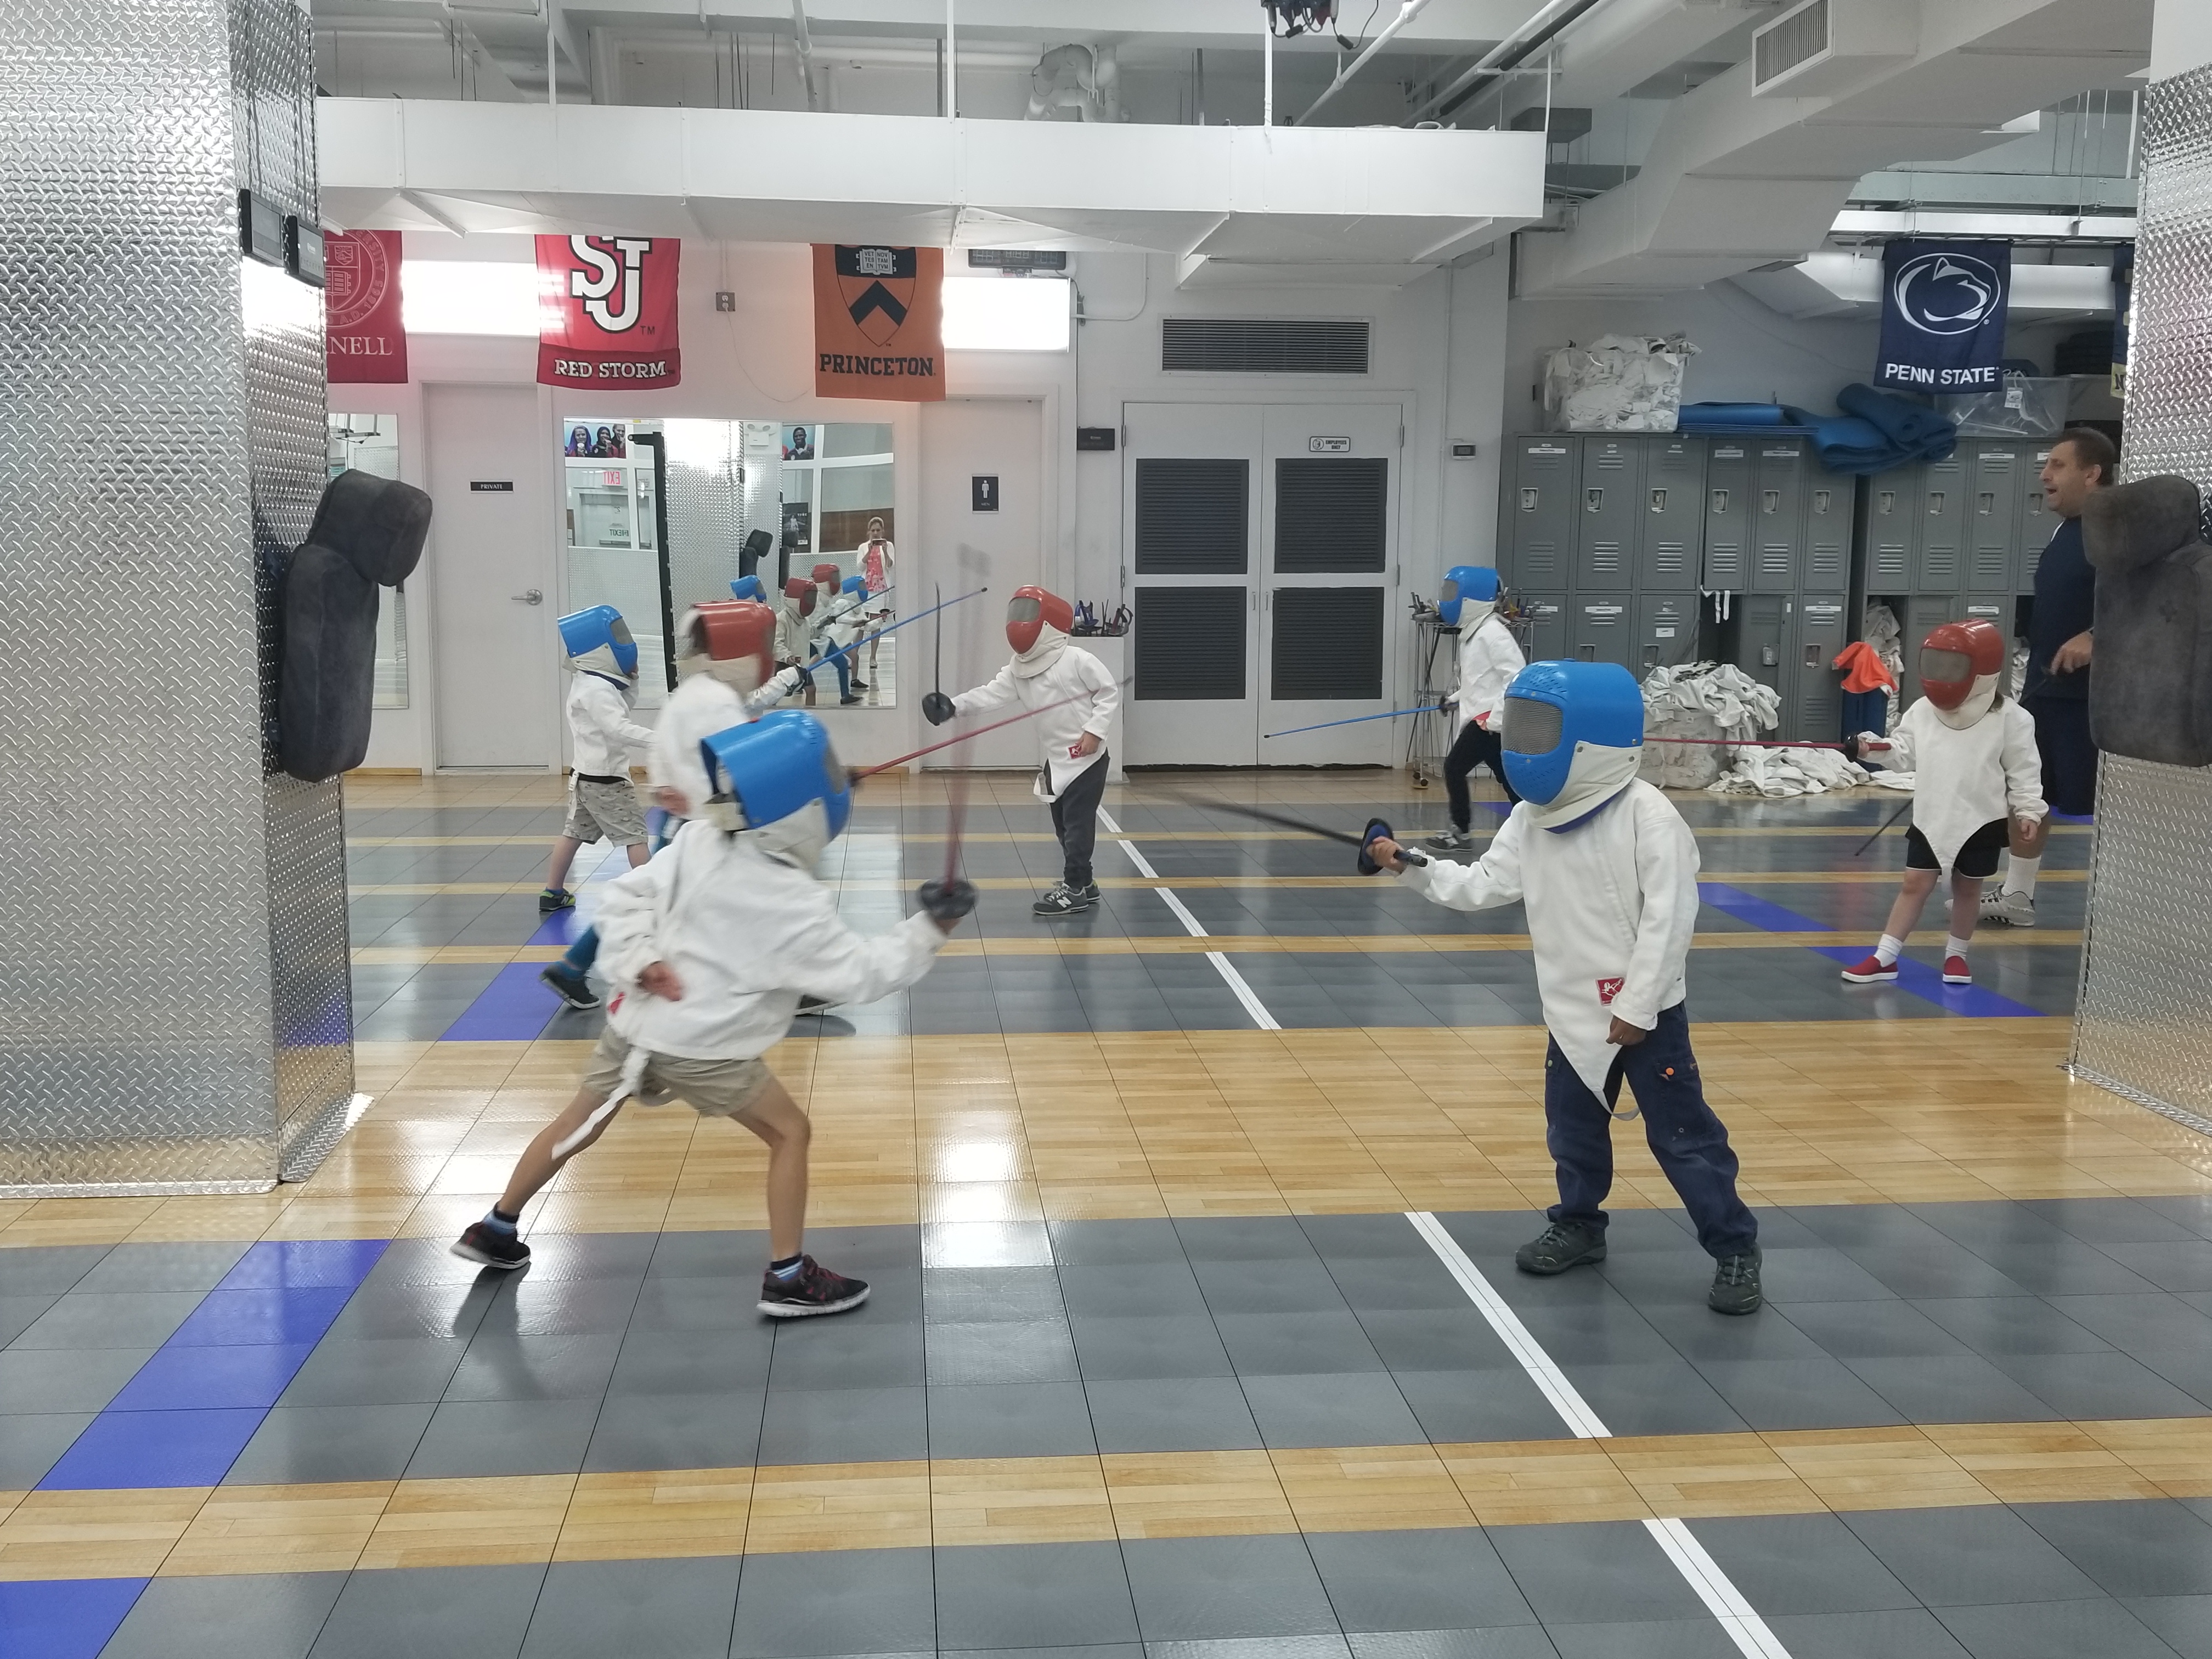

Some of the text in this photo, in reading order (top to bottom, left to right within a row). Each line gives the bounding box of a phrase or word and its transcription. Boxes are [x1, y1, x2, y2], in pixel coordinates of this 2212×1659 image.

[640, 326, 656, 335] TM
[326, 336, 392, 356] NELL
[554, 359, 667, 379] RED STORM
[820, 353, 933, 376] PRINCETON
[1885, 363, 1995, 385] PENN STATE
